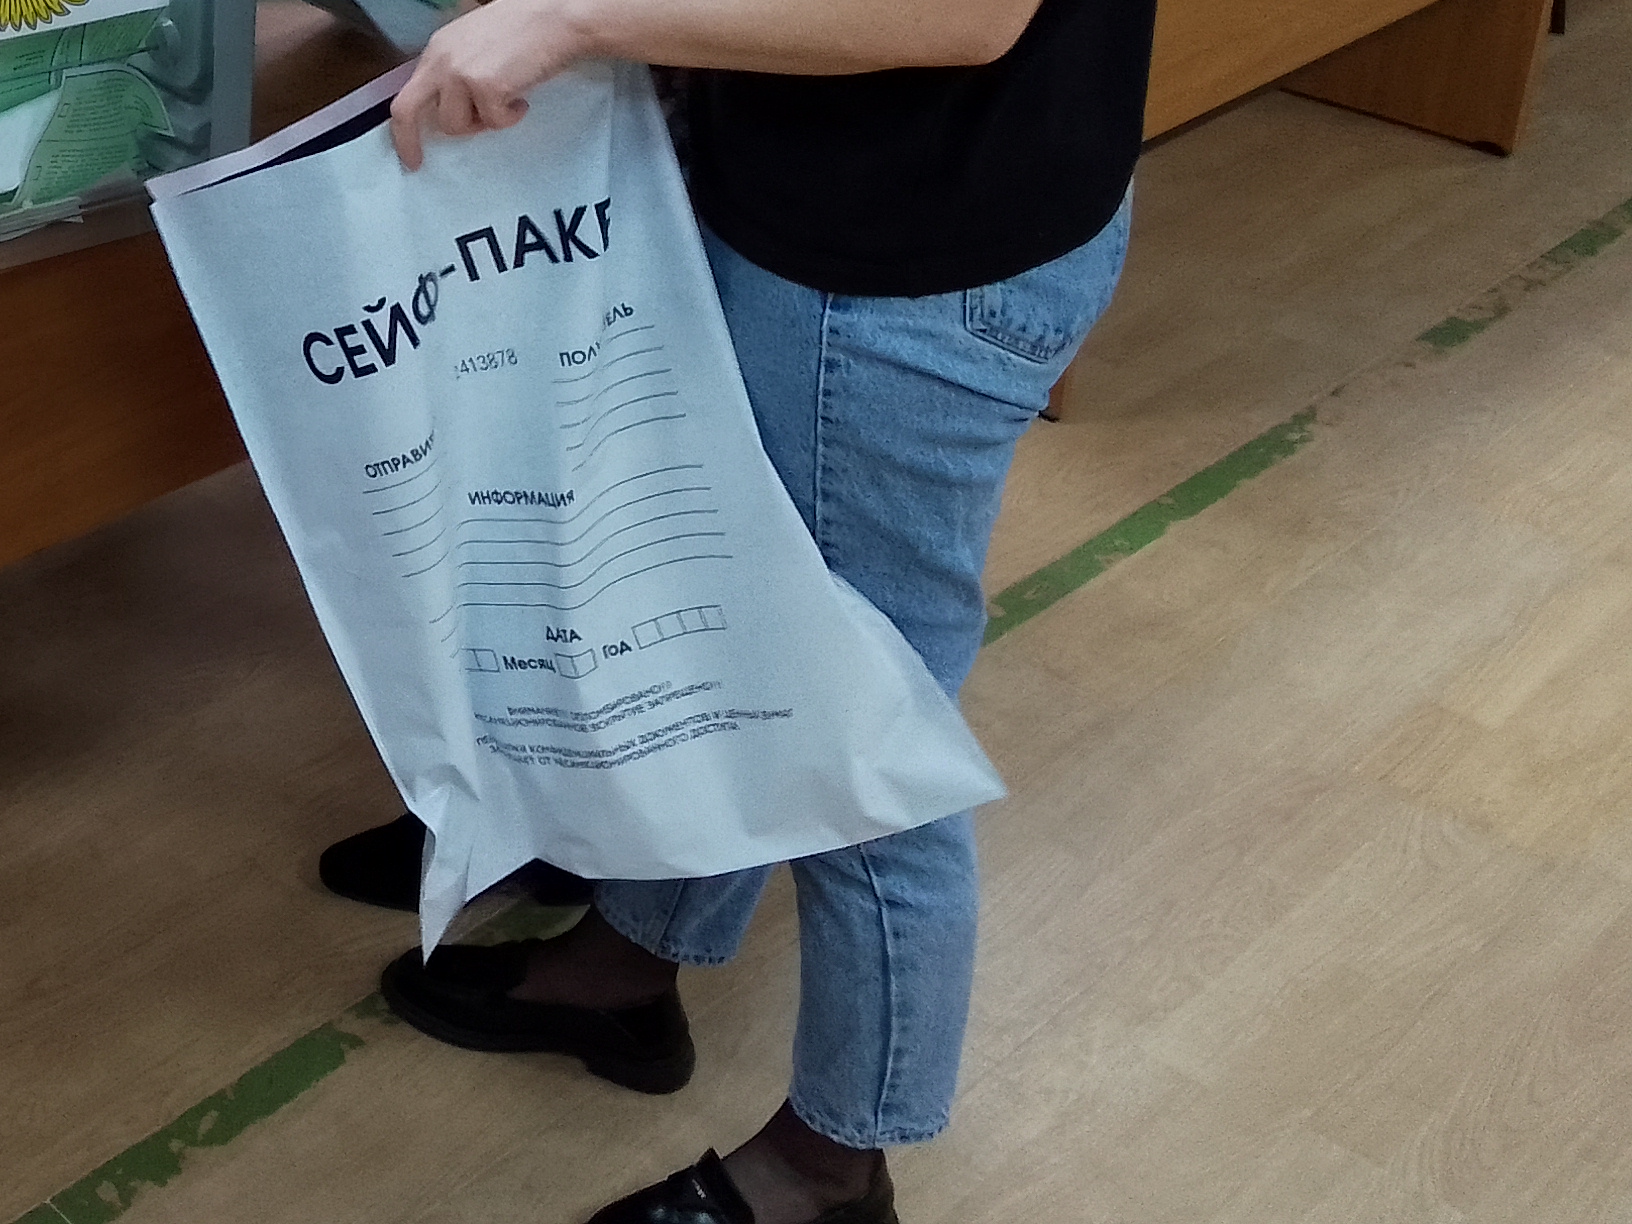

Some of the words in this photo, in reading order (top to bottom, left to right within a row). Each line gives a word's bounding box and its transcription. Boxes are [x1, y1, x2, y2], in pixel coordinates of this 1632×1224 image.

[454, 347, 519, 381] 413878
[467, 488, 575, 510] ИНФОРМАЦИЯ
[545, 625, 583, 644] ДАТА
[502, 655, 557, 674] Месяц
